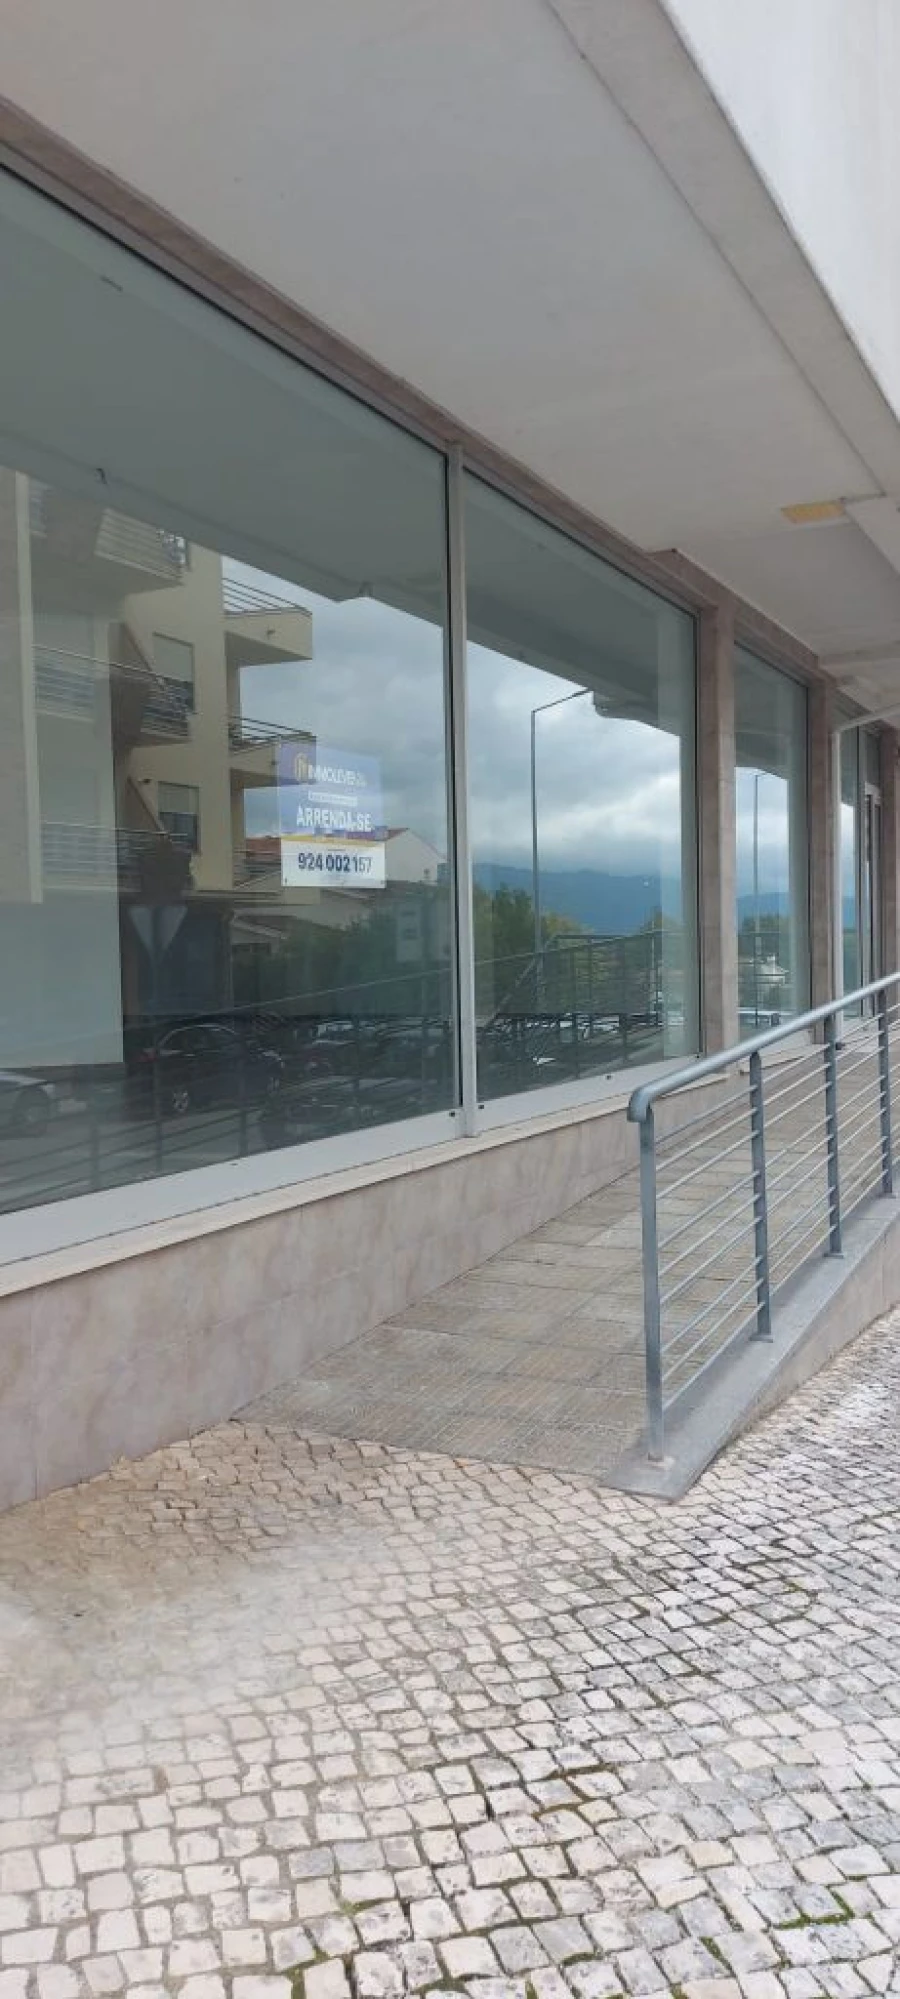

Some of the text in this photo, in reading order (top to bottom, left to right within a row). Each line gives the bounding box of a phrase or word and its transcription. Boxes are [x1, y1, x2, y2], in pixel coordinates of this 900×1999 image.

[296, 804, 372, 832] ARRENDA-SE
[298, 852, 372, 873] 924 002 157
